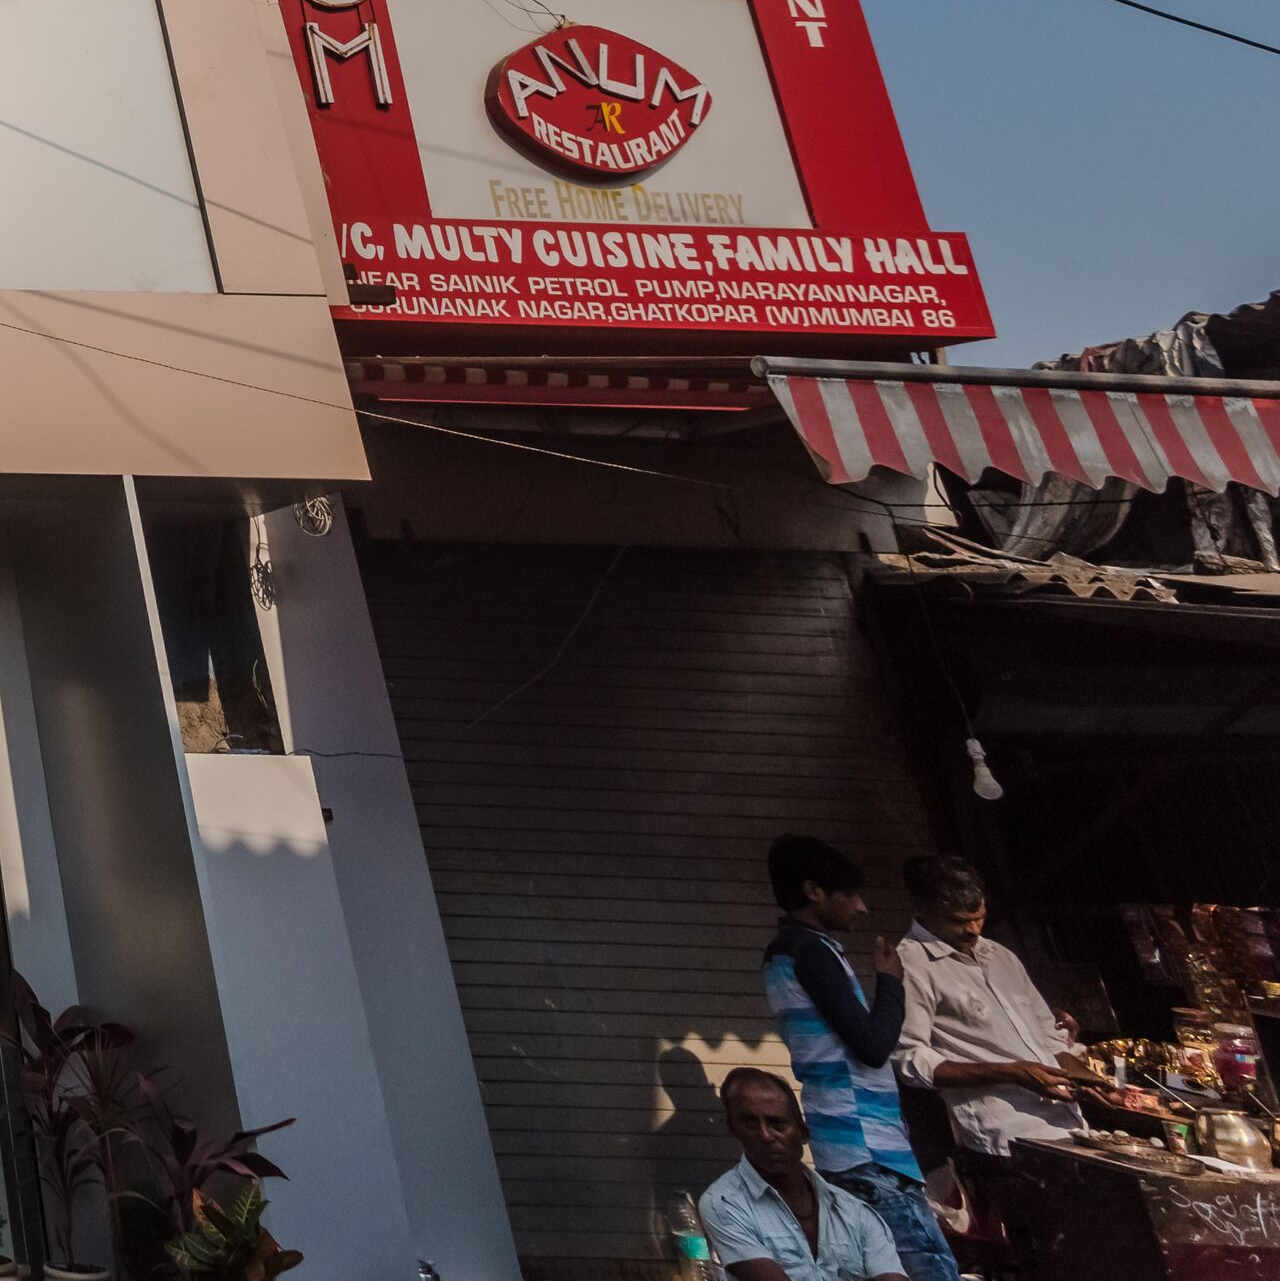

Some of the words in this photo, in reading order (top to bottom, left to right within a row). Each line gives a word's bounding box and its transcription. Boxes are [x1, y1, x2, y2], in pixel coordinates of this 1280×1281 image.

[507, 38, 708, 126] ANUM
[531, 109, 687, 169] RESTAURANT
[393, 223, 522, 264] MULTY
[864, 237, 968, 275] HALL
[430, 273, 520, 295] SAINIK
[527, 276, 628, 298] PETROL
[921, 309, 956, 328] 86
